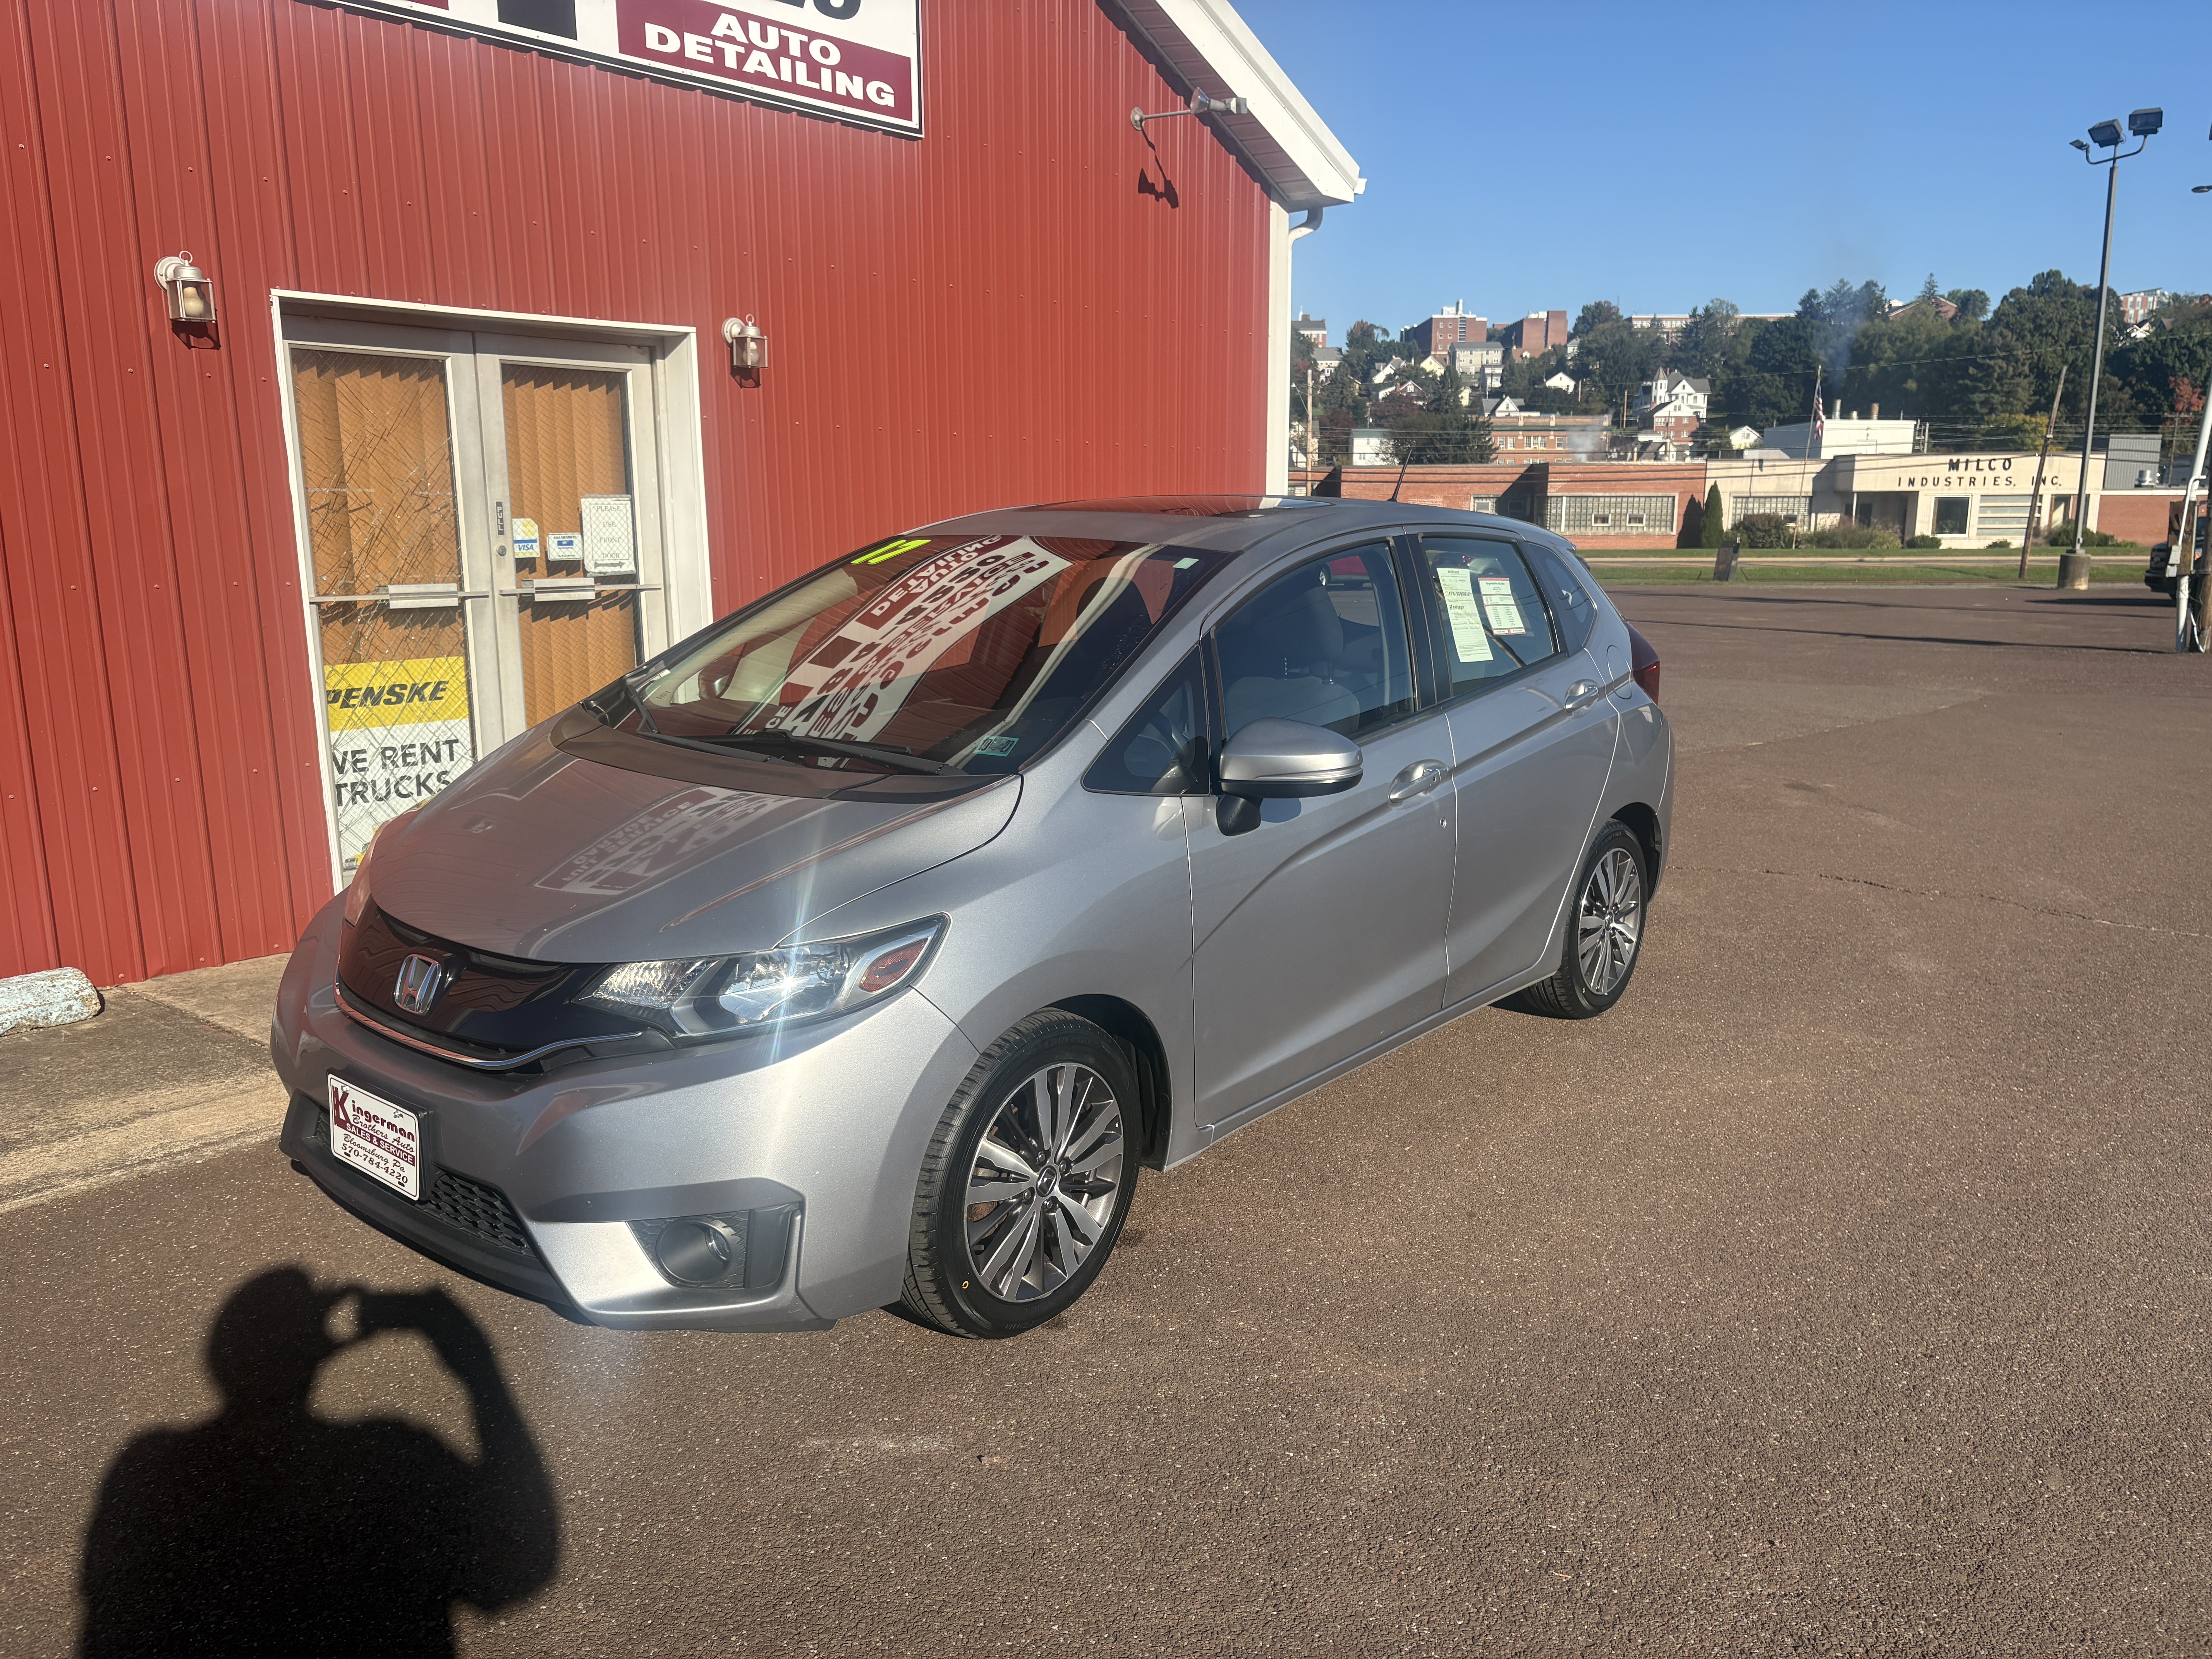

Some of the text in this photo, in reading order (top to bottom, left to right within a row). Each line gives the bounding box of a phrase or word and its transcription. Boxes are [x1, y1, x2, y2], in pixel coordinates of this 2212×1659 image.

[711, 13, 841, 65] AUTO
[645, 22, 895, 107] DETAILING
[1948, 458, 2012, 472] MILCO
[2032, 476, 2062, 487] INC.
[326, 681, 448, 709] PENSKE
[381, 739, 459, 769] RENT
[335, 770, 452, 807] TRUCKS
[332, 1085, 415, 1142] Kingerman
[352, 1114, 414, 1152] Brothers Auto
[343, 1133, 406, 1173] Bloomsburg Pa
[346, 1123, 414, 1164] SALES & SERVICE
[342, 1143, 408, 1184] 570-784-4220
